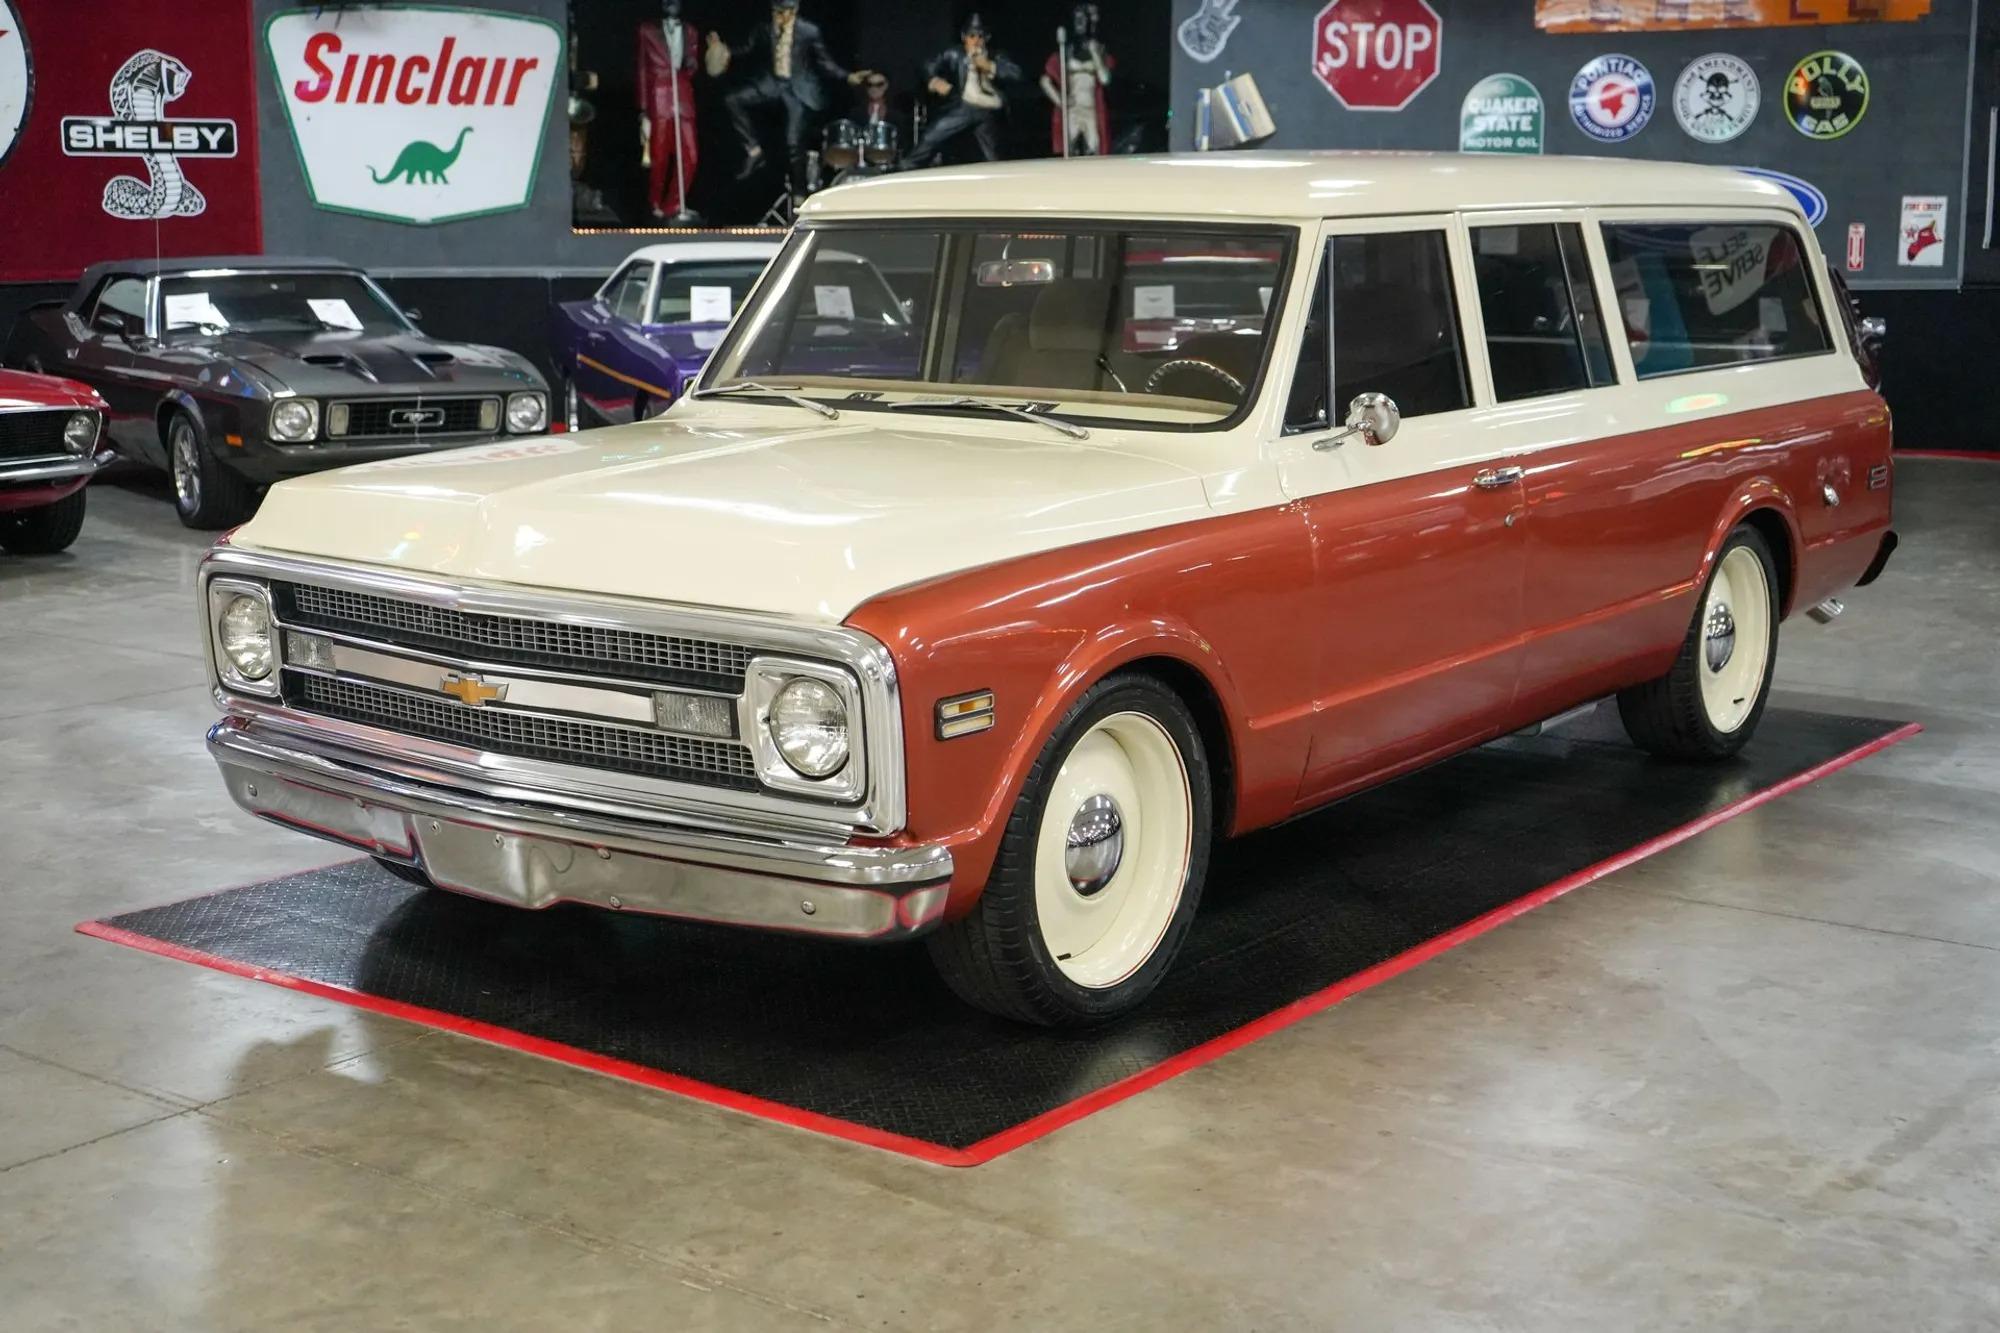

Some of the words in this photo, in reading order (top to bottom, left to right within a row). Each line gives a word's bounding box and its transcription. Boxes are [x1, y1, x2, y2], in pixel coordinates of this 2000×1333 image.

[1323, 22, 1432, 70] STOP
[294, 31, 539, 107] Sinclair
[1575, 58, 1648, 92] PONTIAC
[1789, 57, 1865, 96] POLLY
[1468, 96, 1539, 114] QUAKER
[1473, 114, 1533, 132] STATE
[1801, 112, 1850, 134] GAS
[68, 125, 226, 150] SHELBY
[1464, 136, 1514, 149] MOTOR
[1516, 136, 1539, 149] OIL
